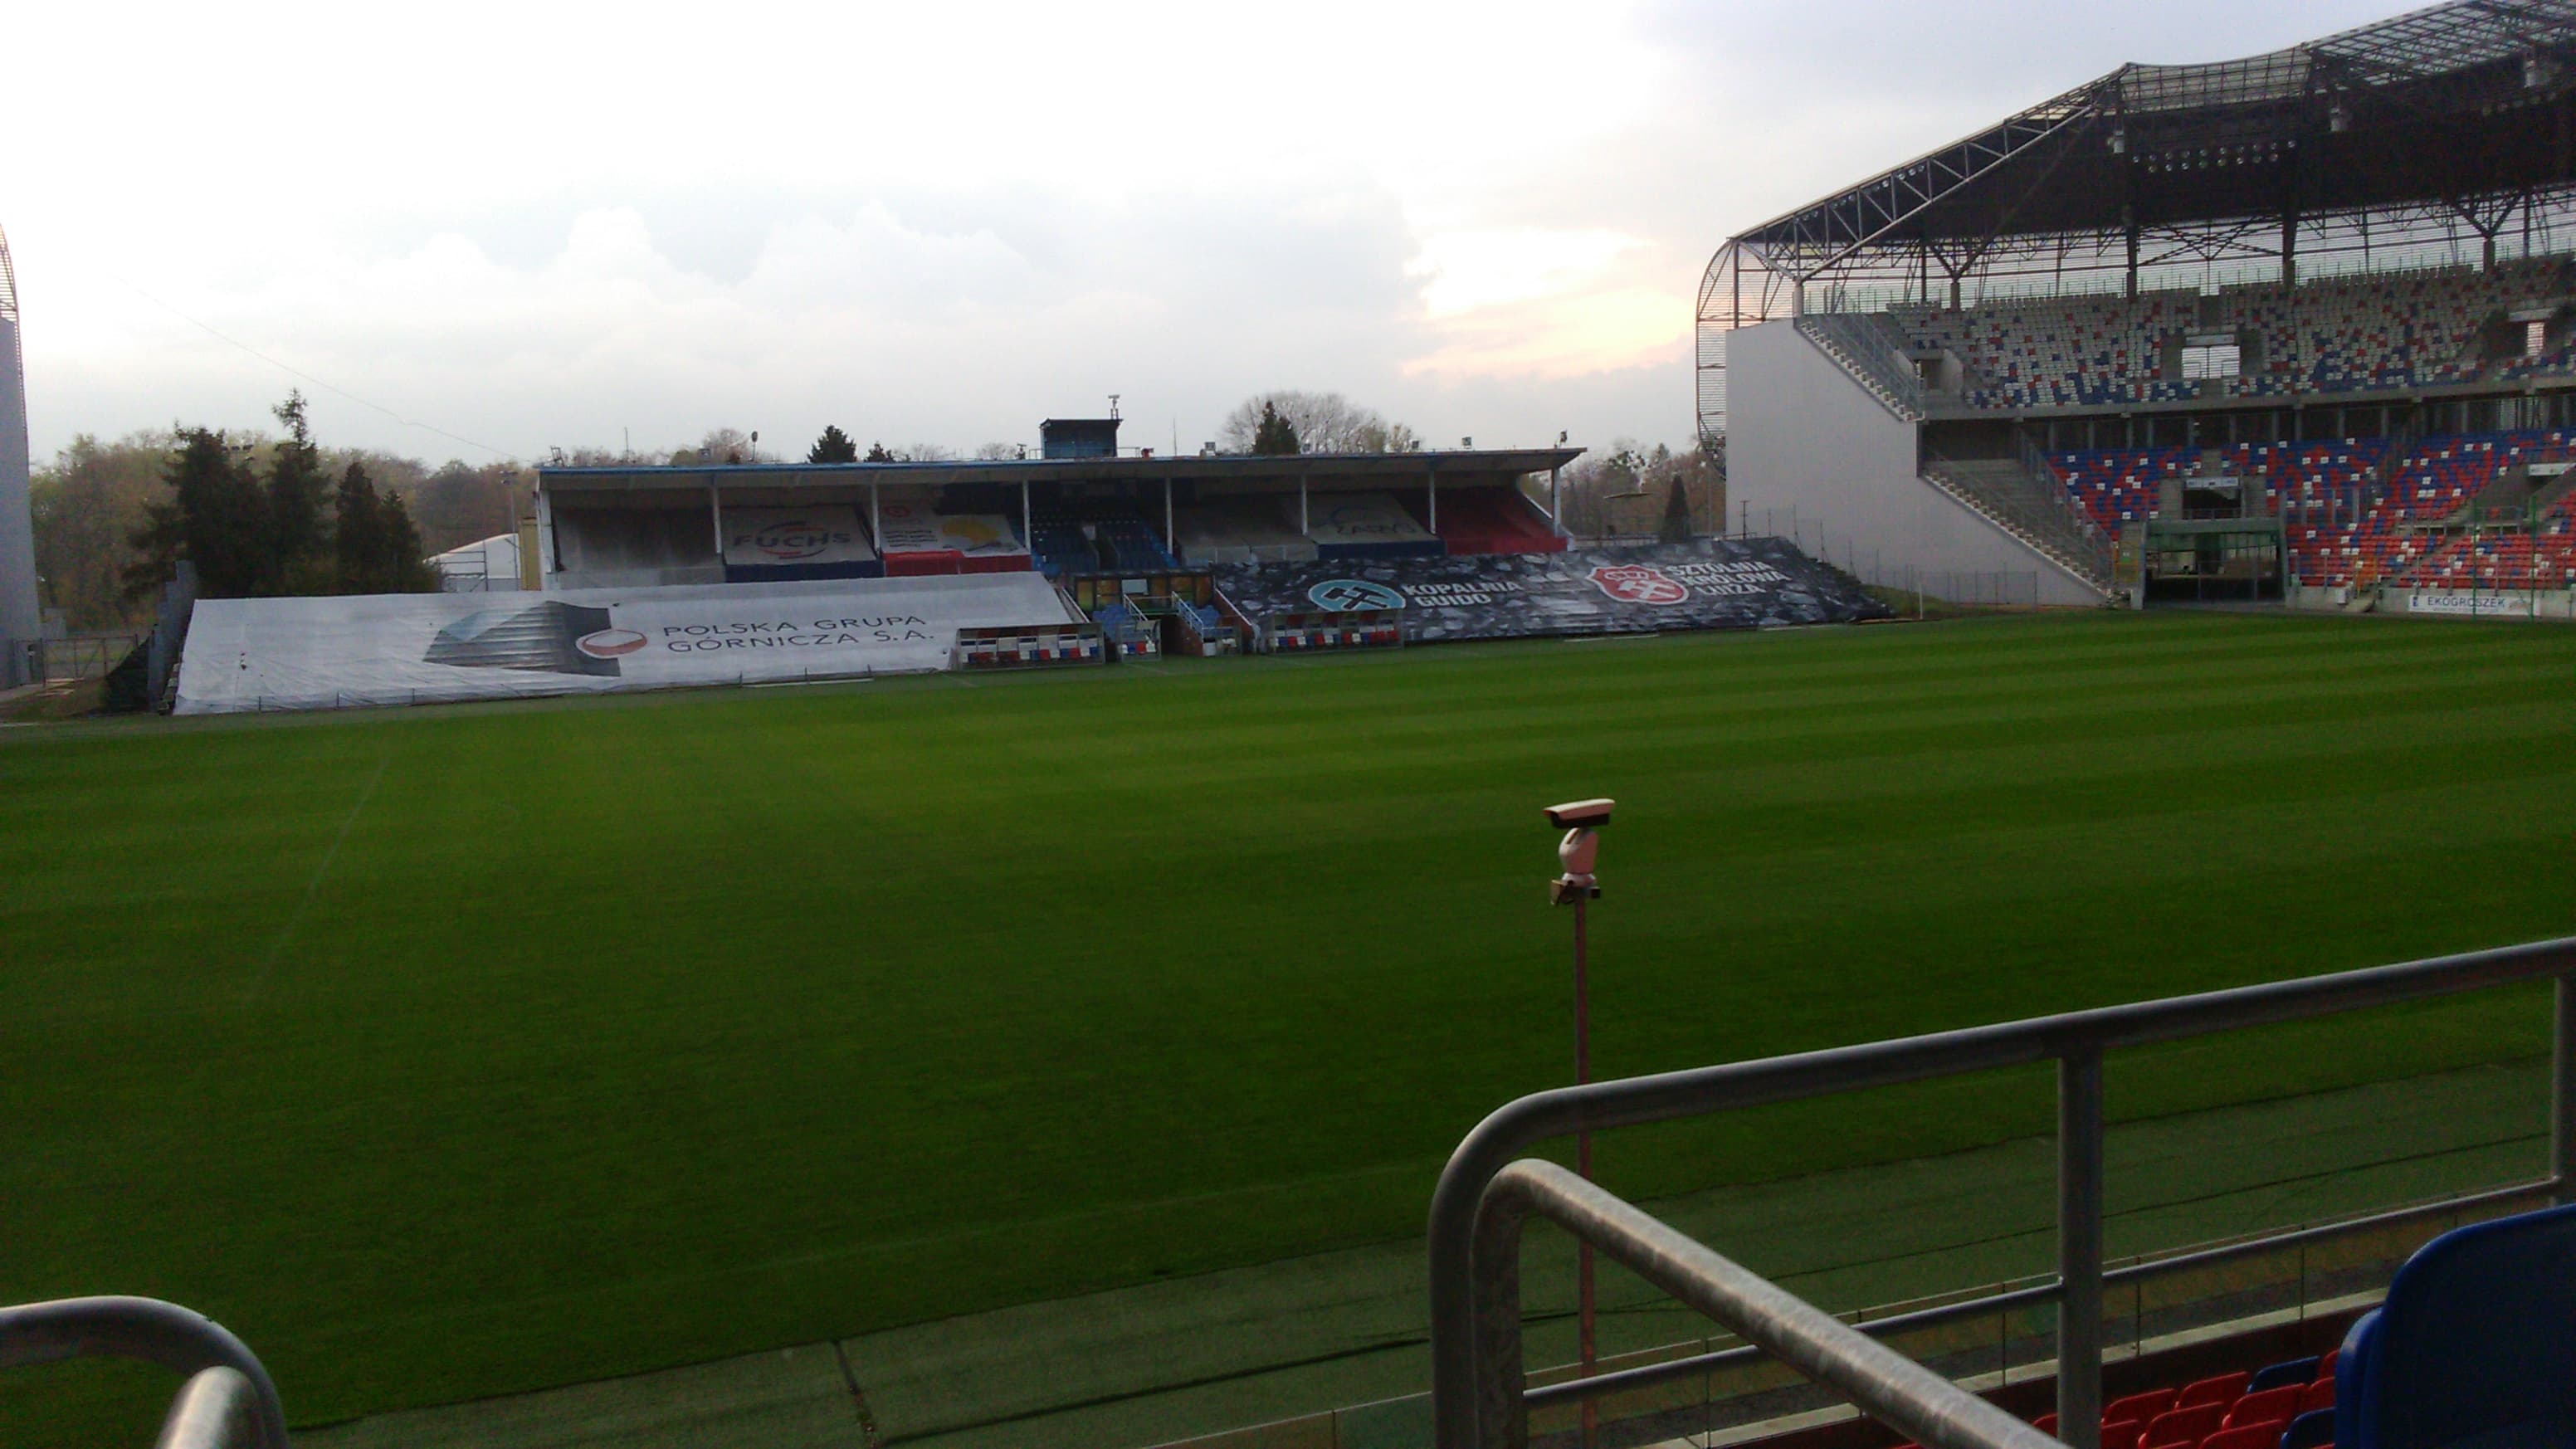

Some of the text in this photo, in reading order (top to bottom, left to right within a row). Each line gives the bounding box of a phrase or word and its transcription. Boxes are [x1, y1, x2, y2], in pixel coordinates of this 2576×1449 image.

[733, 532, 850, 547] FUCHS
[1666, 561, 1774, 576] SZTOLNIA
[1400, 581, 1525, 595] KOPALNIA
[1695, 584, 1767, 596] LUIZA
[1414, 593, 1491, 607] GUIDO
[2427, 596, 2505, 608] EKOGROSZEK
[664, 616, 926, 637] POLSKA GRUPA
[667, 633, 859, 652] GÓRNICZA
